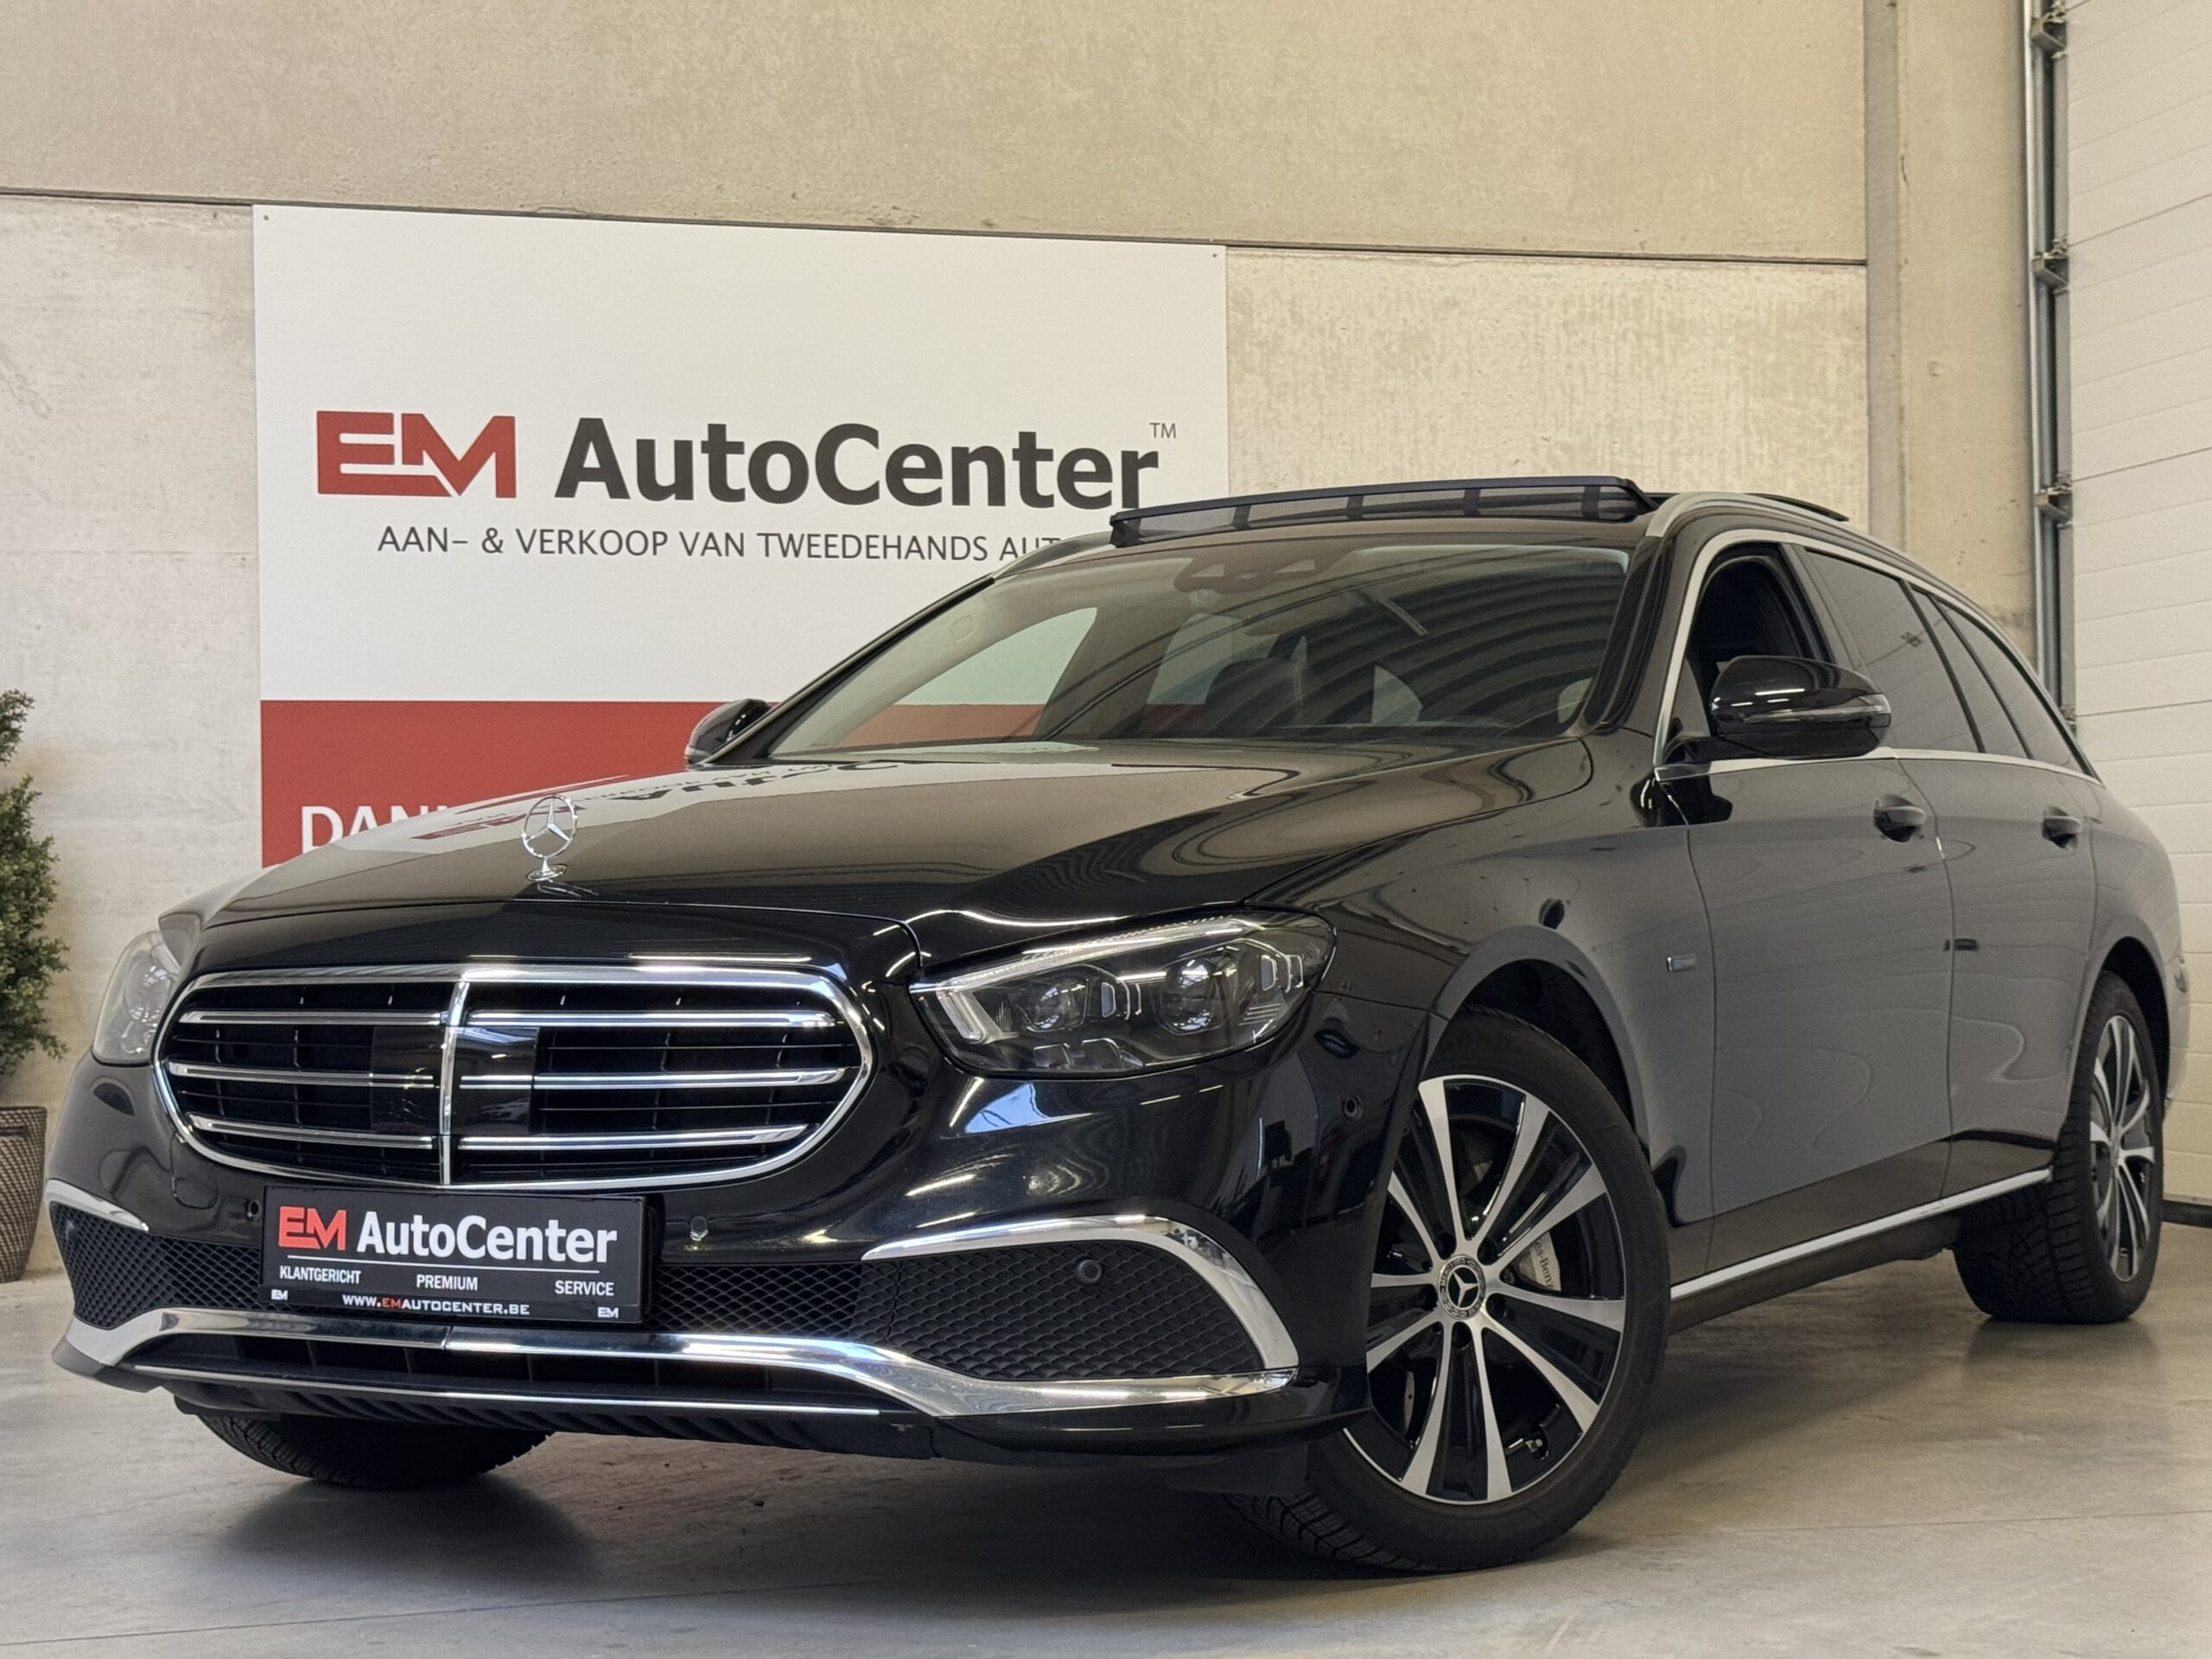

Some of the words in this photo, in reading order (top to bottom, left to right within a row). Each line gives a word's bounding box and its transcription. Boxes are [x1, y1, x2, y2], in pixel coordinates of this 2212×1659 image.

[317, 410, 517, 499] EM
[555, 417, 1159, 510] AutoCenter
[481, 528, 504, 554] &
[516, 529, 669, 557] VERKOOP
[679, 531, 745, 557] VAN
[757, 532, 988, 562] TWEEDEHANDS
[999, 537, 1061, 562] AU
[278, 1206, 346, 1250] EM
[357, 1211, 618, 1263] AutoCenter
[279, 1265, 362, 1284] KLANTGERICHT
[416, 1274, 479, 1291] PREMIUM
[270, 1288, 289, 1301] EM
[554, 1280, 614, 1296] SERVICE
[342, 1294, 530, 1315] WWW.EMAUTOCENTER.BE
[597, 1306, 620, 1319] EM
